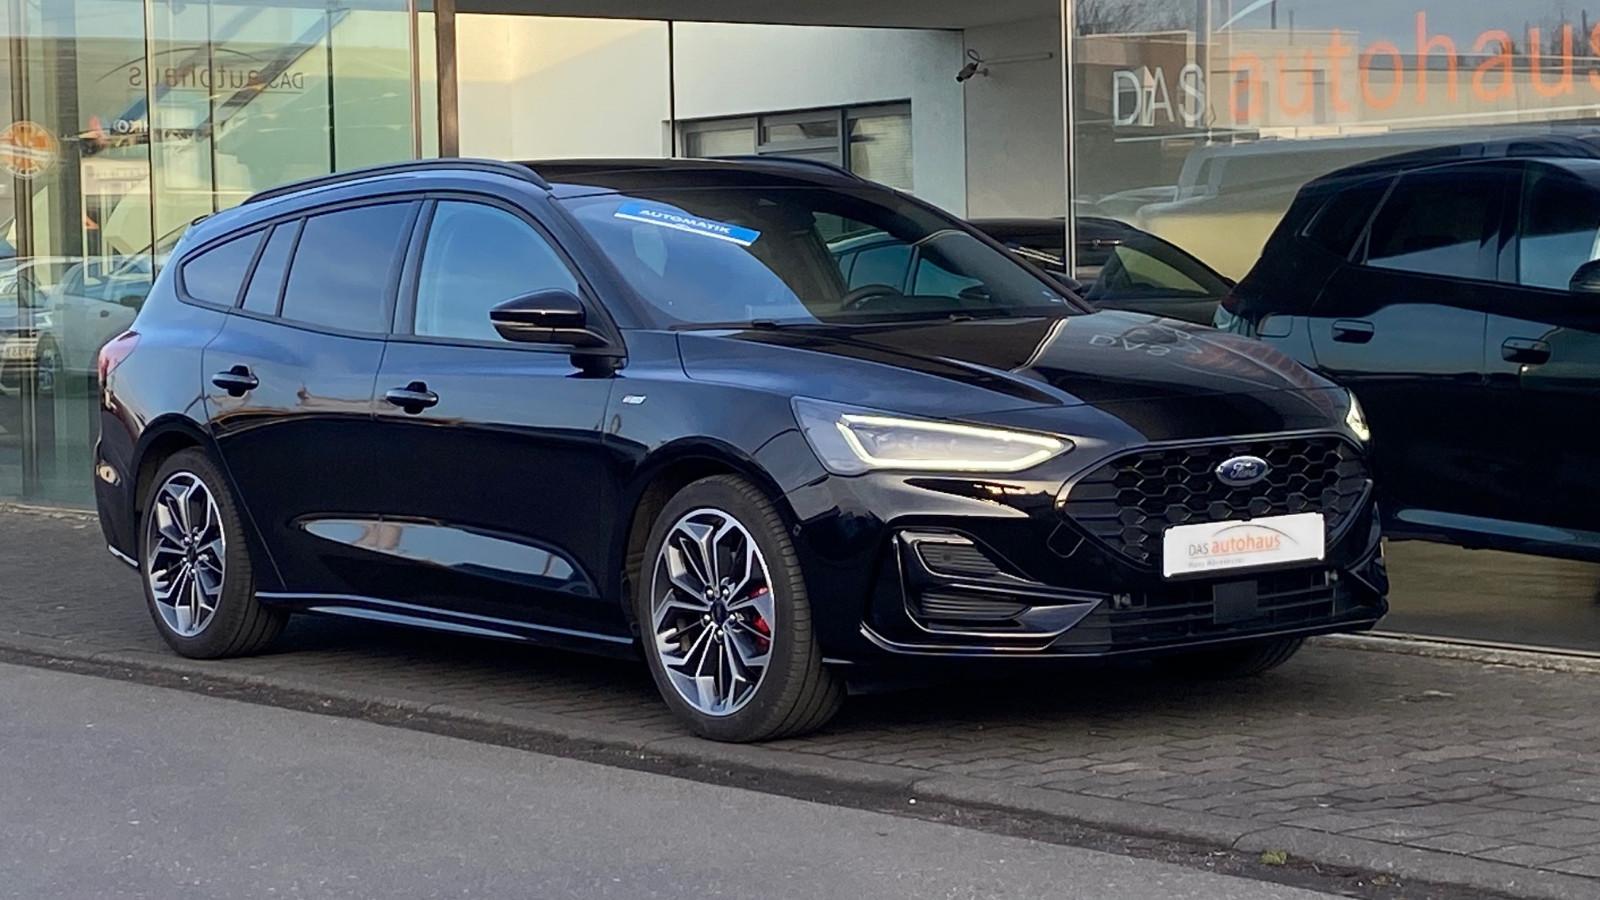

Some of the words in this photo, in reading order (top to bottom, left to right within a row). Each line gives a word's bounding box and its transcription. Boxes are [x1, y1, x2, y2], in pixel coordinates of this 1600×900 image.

[1112, 63, 1206, 127] DAS
[638, 209, 732, 235] AUTOMATIK
[1230, 461, 1259, 479] Ford
[1188, 543, 1209, 557] DAS
[1211, 533, 1281, 555] autohaus
